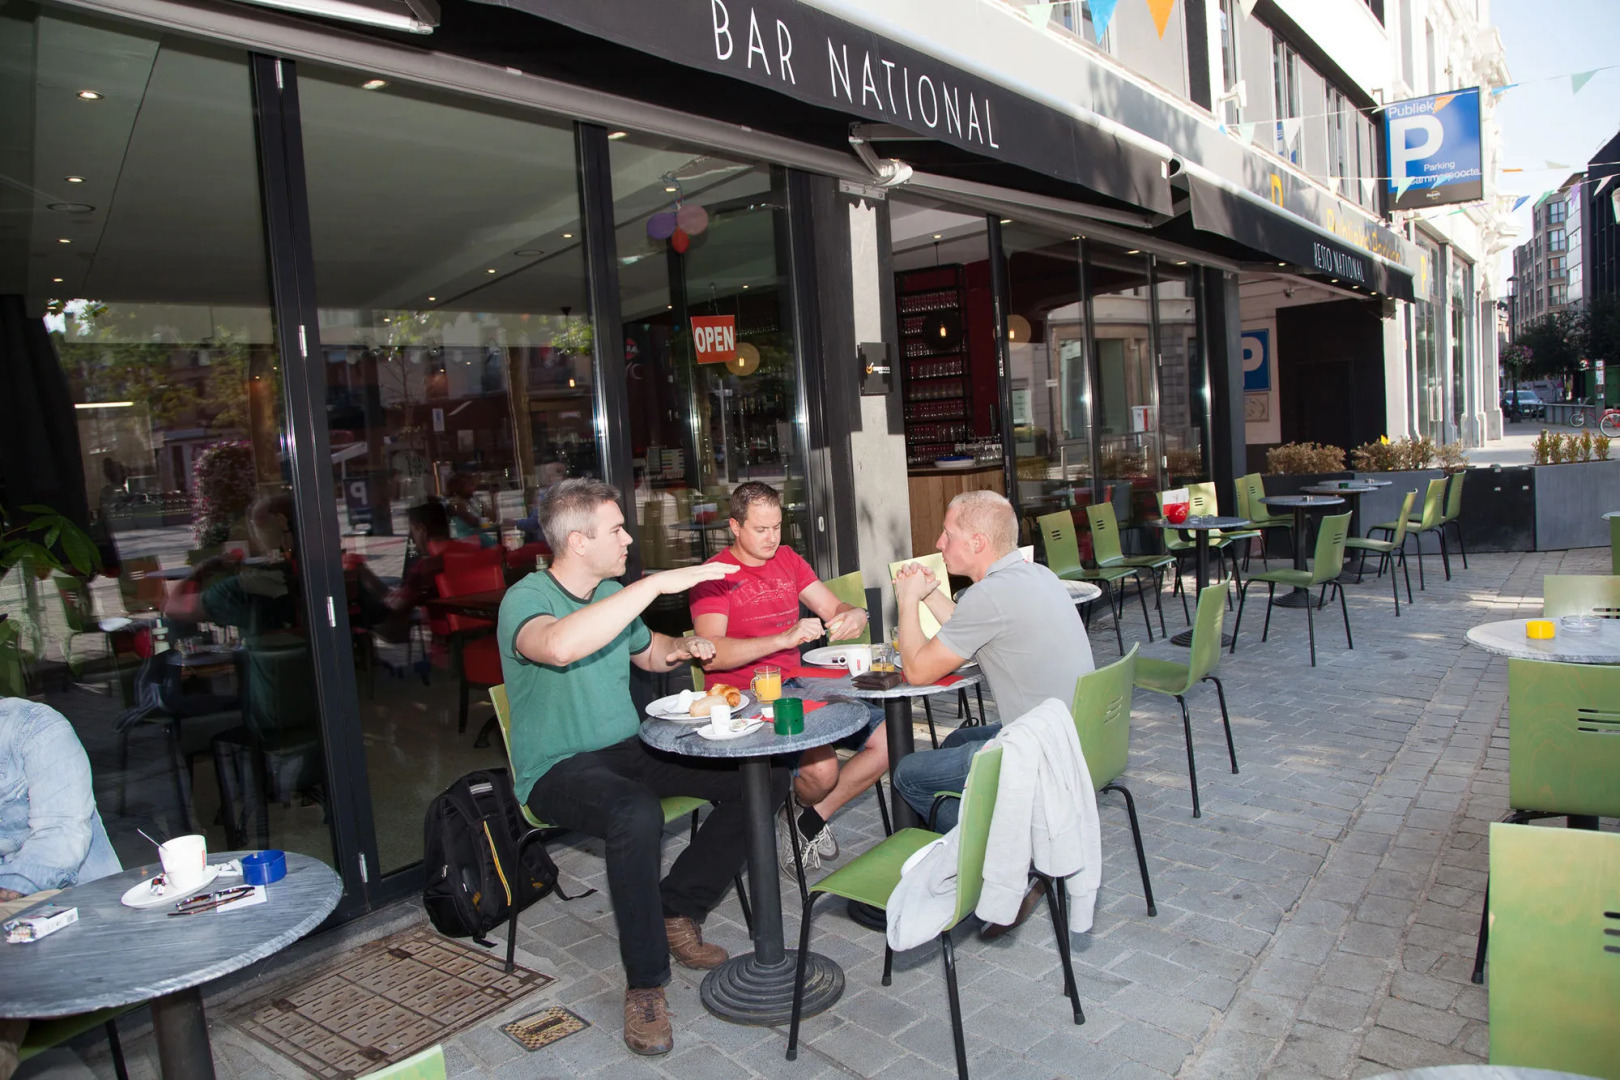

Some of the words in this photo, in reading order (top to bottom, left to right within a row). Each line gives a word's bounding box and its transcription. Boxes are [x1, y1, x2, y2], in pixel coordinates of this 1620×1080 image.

[711, 0, 796, 85] BAR
[827, 37, 999, 149] NATIONAL
[1388, 103, 1434, 118] Publiek
[1389, 114, 1444, 188] P
[1424, 161, 1455, 172] Parking
[1313, 242, 1333, 272] RESTO
[1333, 249, 1365, 283] NATIONAL
[694, 325, 735, 354] OPEN
[1241, 336, 1264, 389] P
